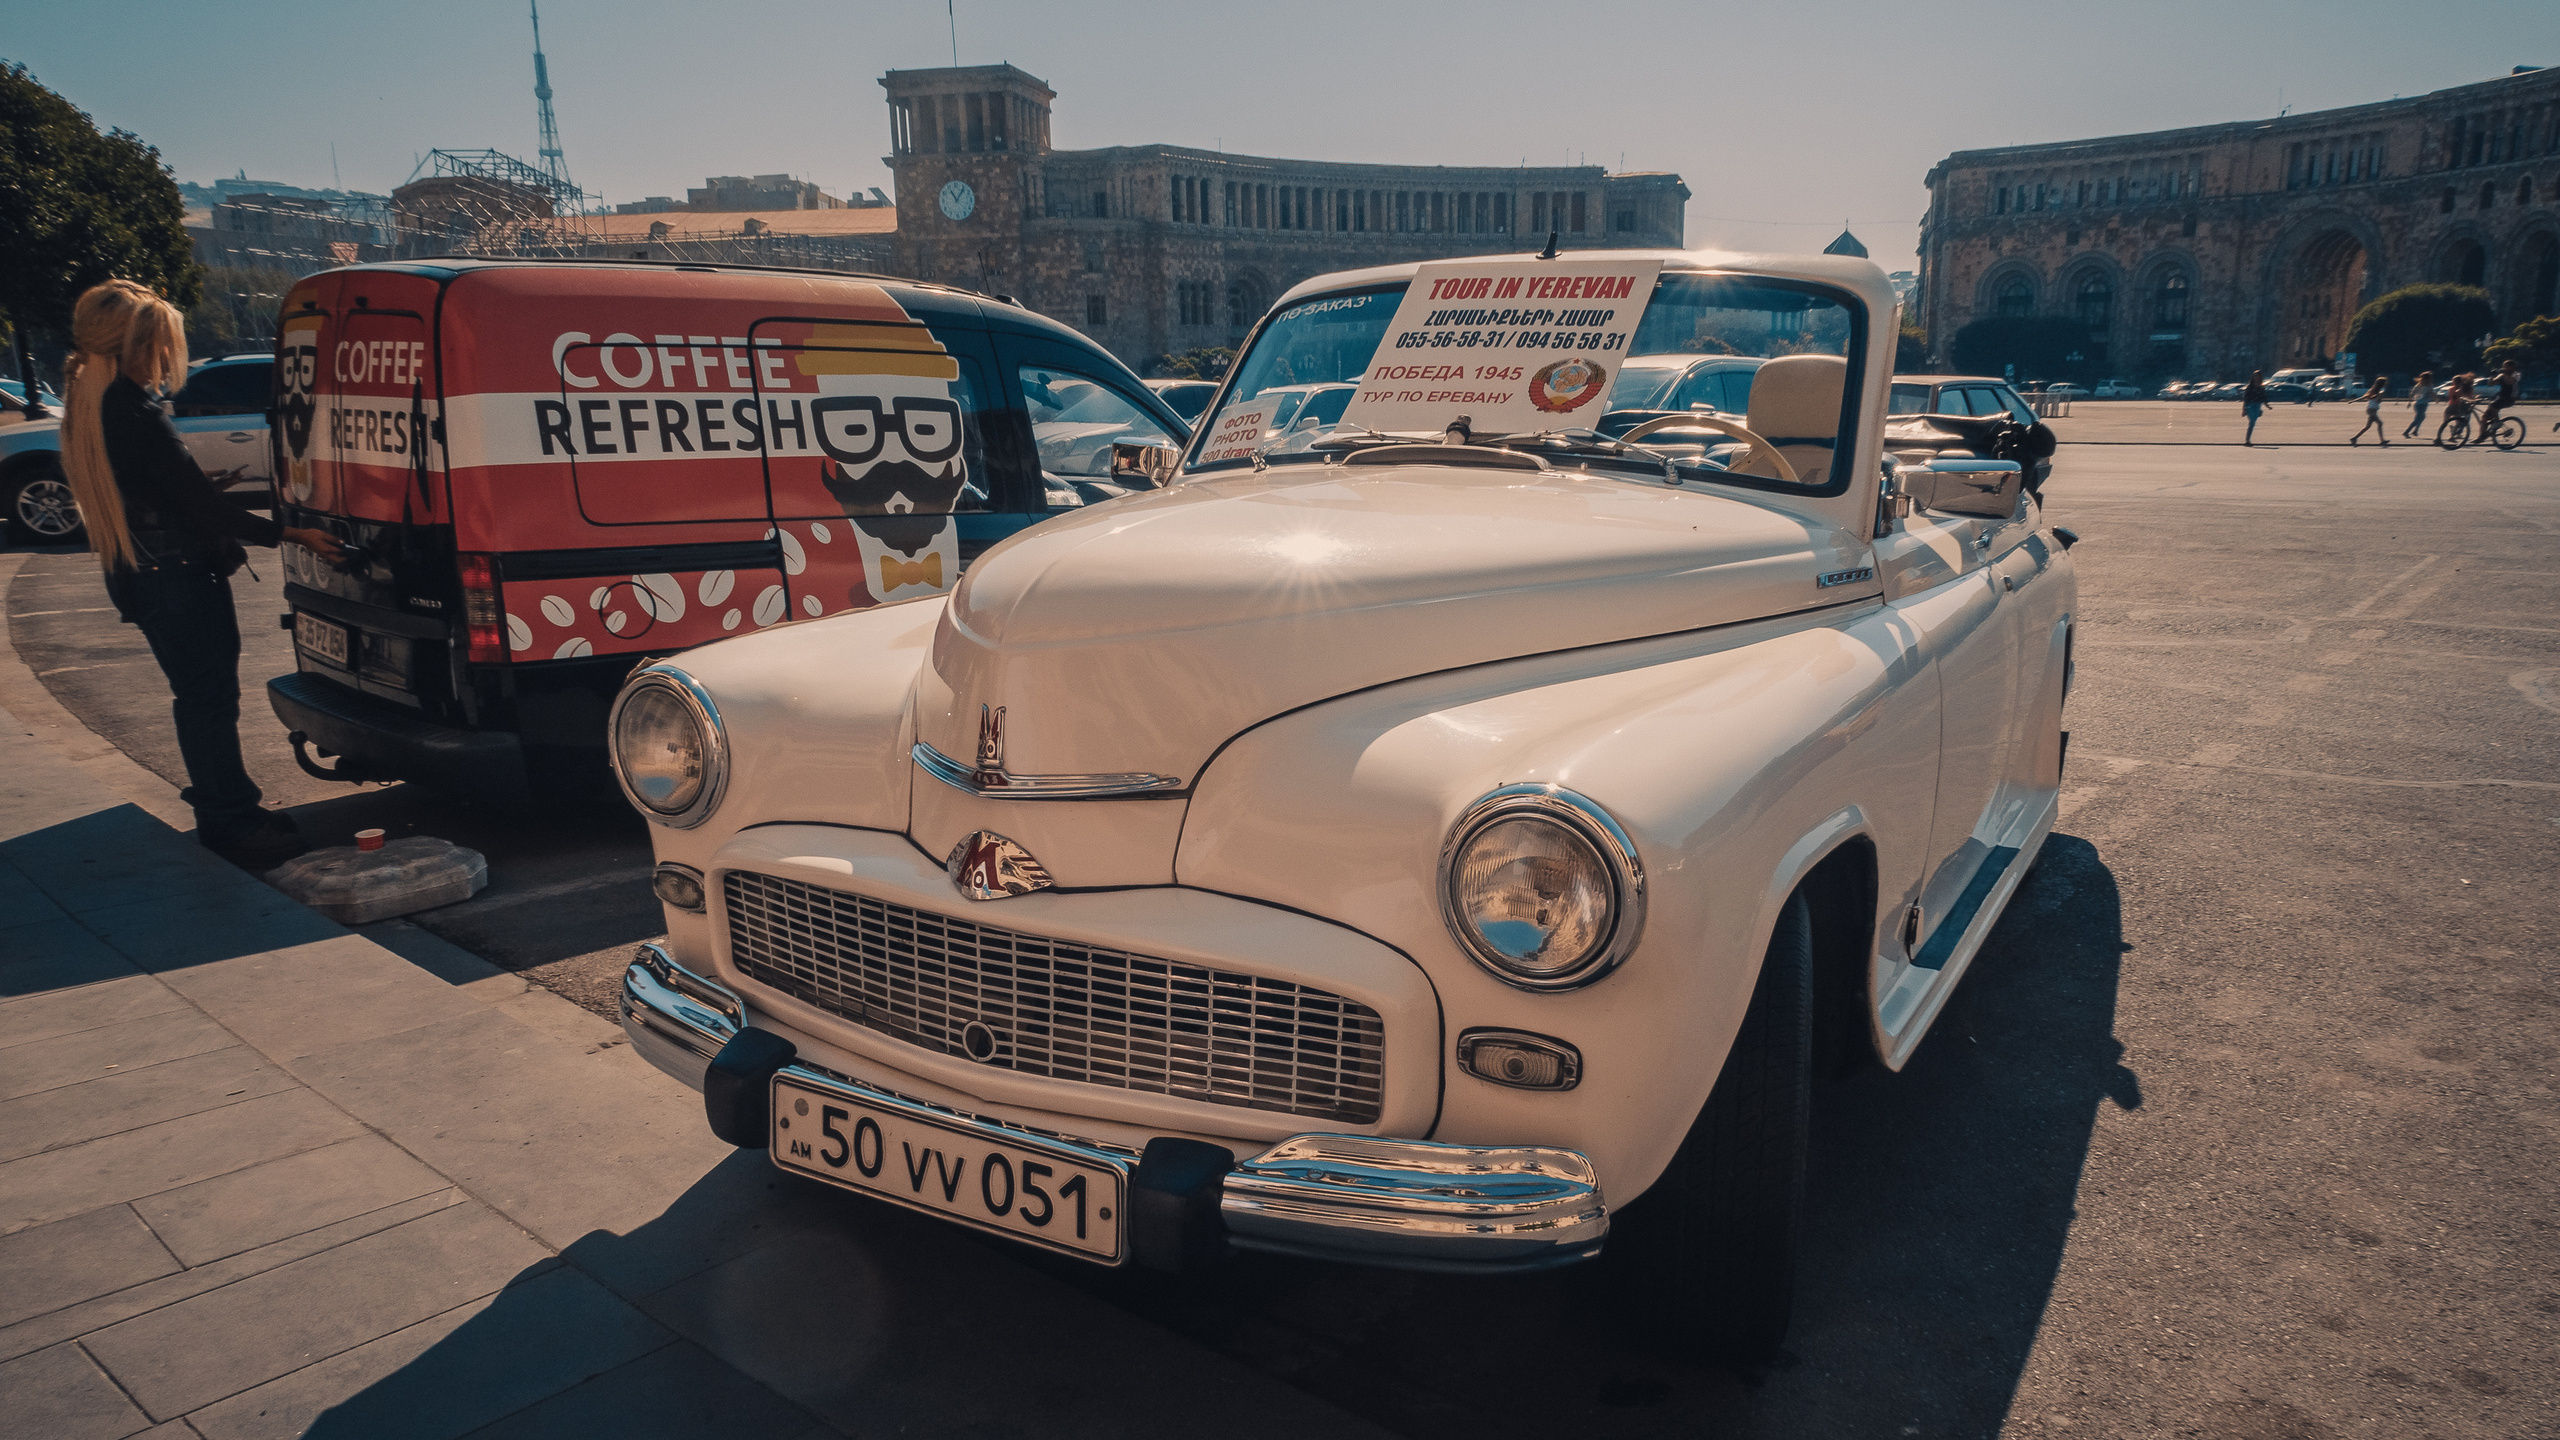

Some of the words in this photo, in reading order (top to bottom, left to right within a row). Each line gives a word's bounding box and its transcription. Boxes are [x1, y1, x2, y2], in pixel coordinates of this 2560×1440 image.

[1429, 278, 1492, 300] TOUR
[1493, 277, 1524, 299] IN
[1527, 276, 1636, 300] YEREVAN
[1304, 296, 1373, 316] ЗАКАЗ
[1554, 310, 1615, 327] ՀԱՄԱՐ
[1396, 330, 1506, 349] 055-56-58-31
[1515, 331, 1549, 348] 094
[1551, 332, 1577, 350] 56
[1577, 332, 1602, 350] 58
[1603, 332, 1627, 351] 31
[335, 340, 425, 385] COFFEE
[552, 331, 792, 388] COFFEE
[1373, 365, 1464, 382] ПОБЕДА
[1474, 365, 1524, 381] 1945
[1363, 391, 1393, 403] ТУР
[1397, 391, 1423, 403] ПО
[1427, 391, 1514, 405] ЕРЕВАНУ
[534, 399, 808, 456] REFRESH
[1224, 412, 1262, 429] ФОТО
[1212, 428, 1258, 447] PHOTO
[1201, 449, 1221, 463] 500
[790, 1139, 812, 1160] AM
[820, 1104, 884, 1178] 50
[902, 1140, 966, 1203] VV
[981, 1152, 1088, 1240] 051
